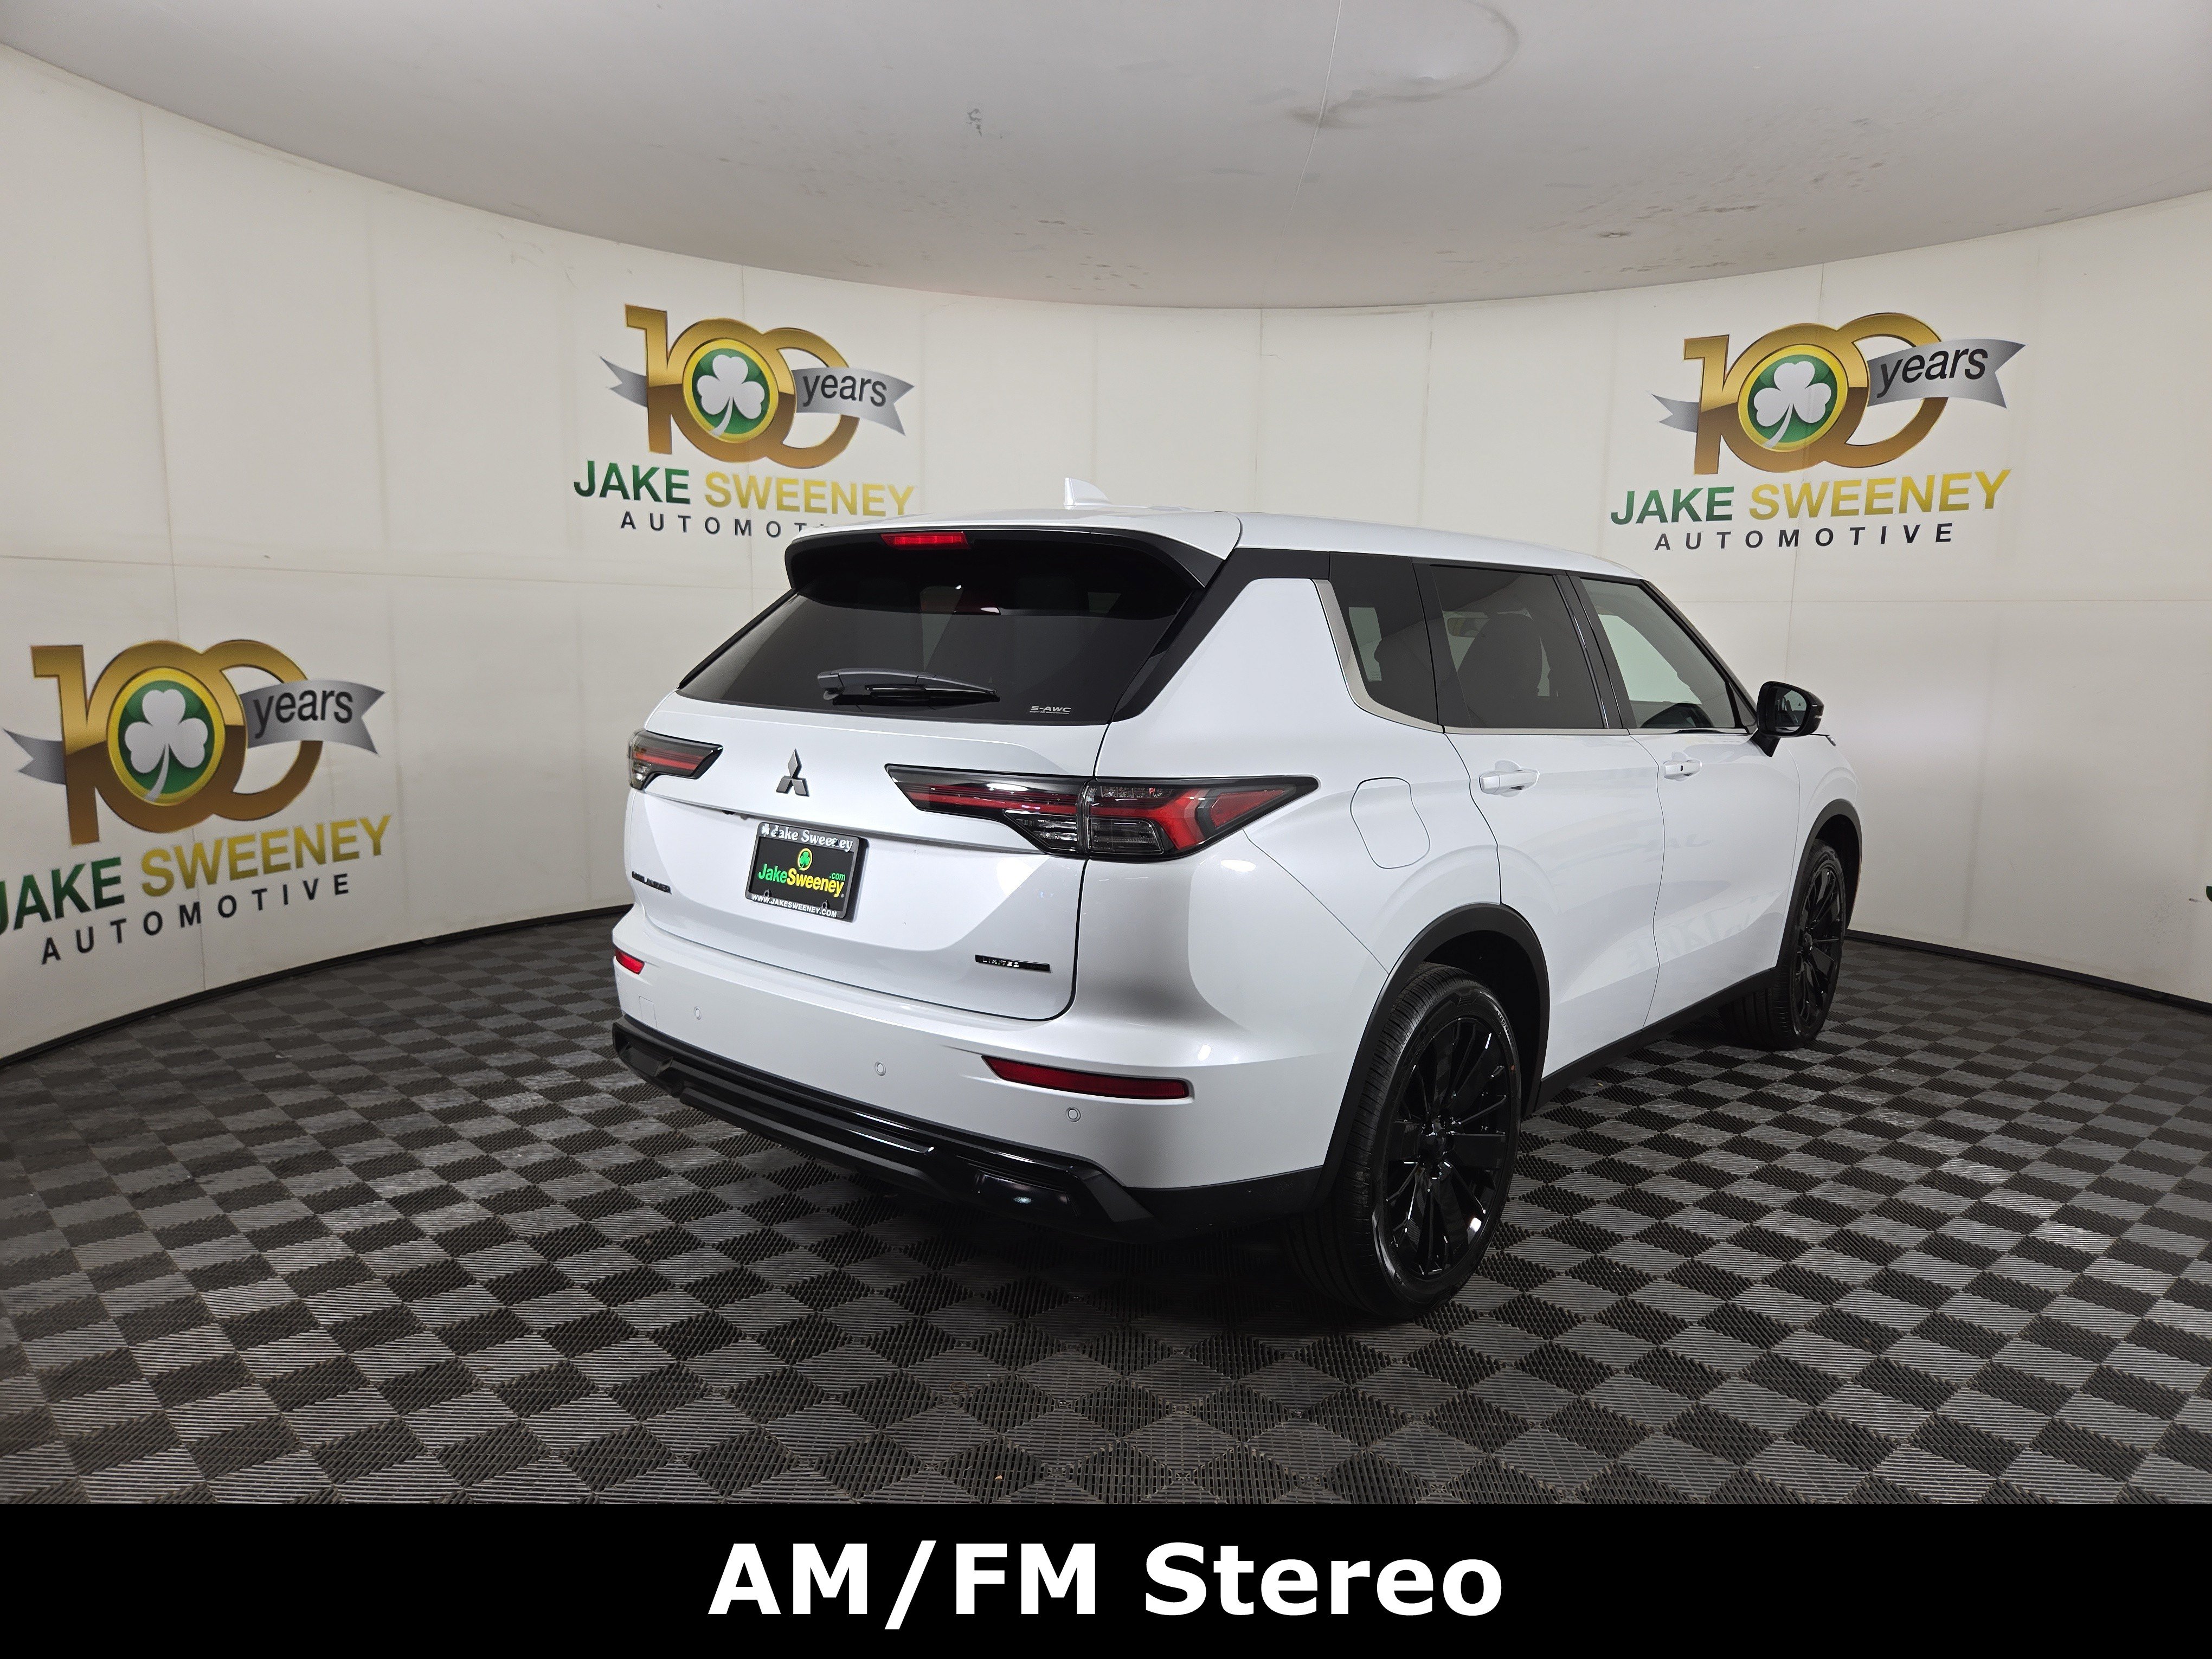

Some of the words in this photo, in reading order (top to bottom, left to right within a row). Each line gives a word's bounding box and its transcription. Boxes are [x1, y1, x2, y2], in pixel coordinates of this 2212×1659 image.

[626, 304, 860, 468] 100
[802, 374, 888, 407] years
[1683, 312, 1948, 475] 100
[1877, 348, 1988, 398] years
[574, 460, 690, 505] JAKE
[705, 471, 915, 517] SWEENEY
[1611, 486, 1735, 525] JAKE
[1749, 469, 2011, 520] SWEENEY
[620, 511, 824, 538] AUTOMOT
[1654, 523, 1953, 551] AUTOMOTIVE
[253, 689, 353, 739] years
[30, 639, 324, 846] 100
[140, 814, 391, 898] SWEENEY
[829, 872, 846, 881] .com
[41, 873, 349, 965] AUTOMOTIVE
[752, 894, 837, 917] WWW.JAKESWEENEY.COM
